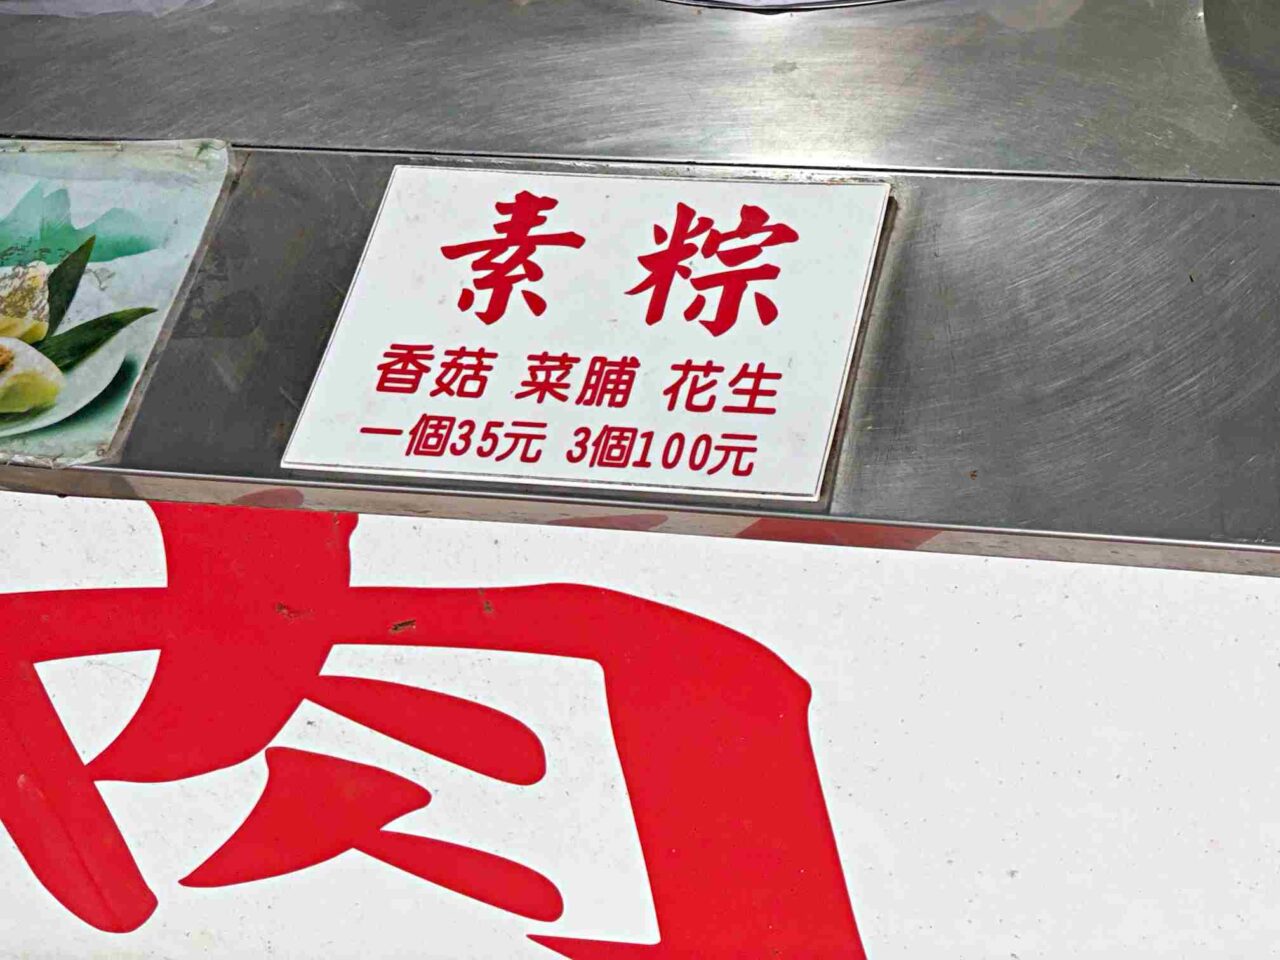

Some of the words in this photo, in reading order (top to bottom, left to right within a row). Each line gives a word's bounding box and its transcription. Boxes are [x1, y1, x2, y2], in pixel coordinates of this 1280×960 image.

[441, 191, 799, 336] 素粽
[376, 344, 497, 397] 香菇
[515, 352, 639, 407] 菜脯
[663, 360, 781, 415] 花生
[360, 414, 547, 462] 一個35元
[566, 425, 756, 476] 3個100元
